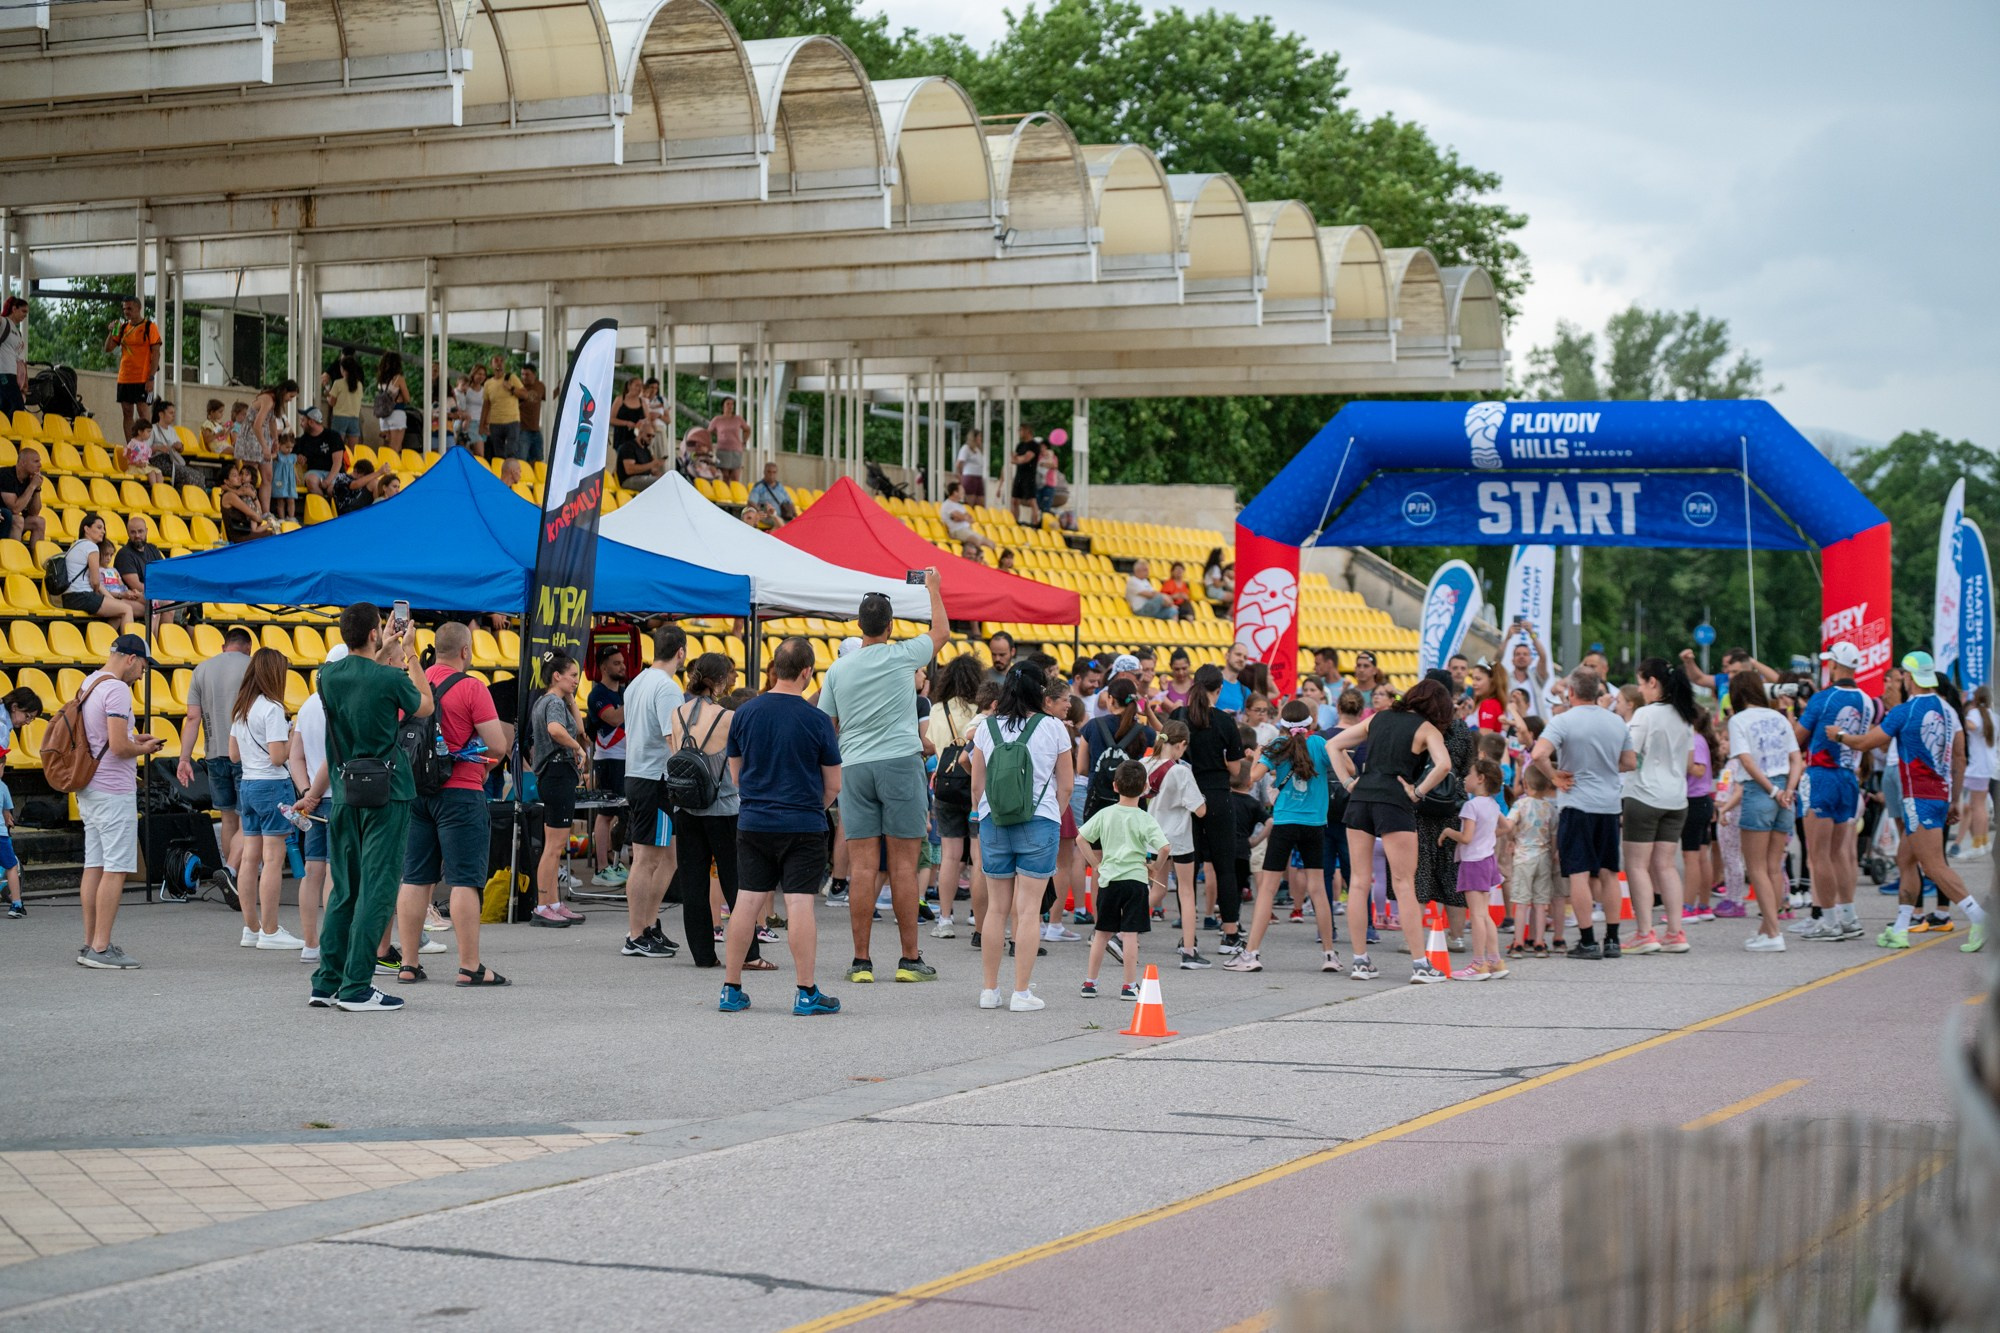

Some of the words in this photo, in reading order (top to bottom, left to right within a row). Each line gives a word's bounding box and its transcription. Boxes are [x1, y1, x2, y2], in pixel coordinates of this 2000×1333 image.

[1510, 412, 1601, 433] PLOVDIV
[1511, 438, 1570, 459] HILLS
[1574, 449, 1633, 457] MARKOVO
[1477, 481, 1642, 535] START
[552, 631, 567, 647] НА
